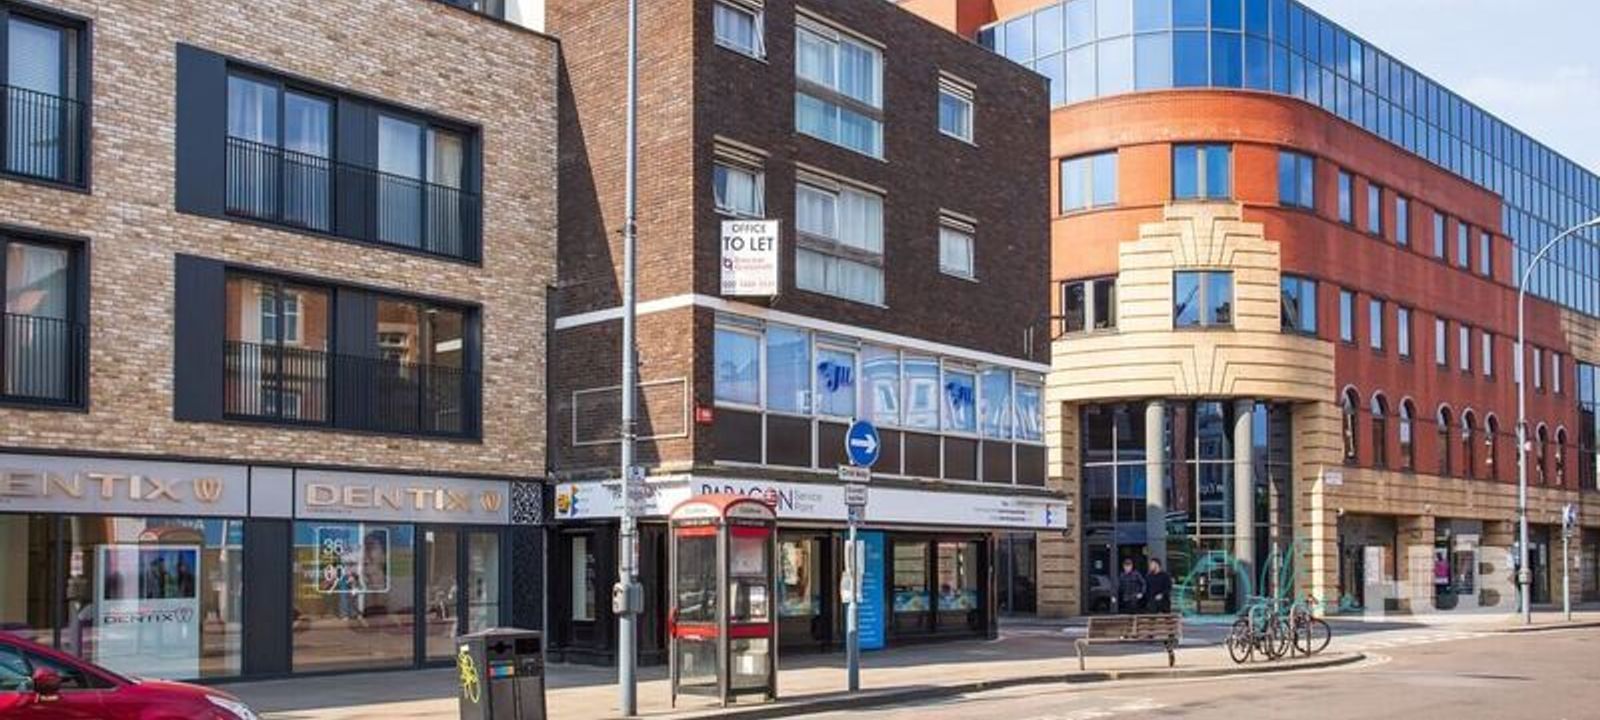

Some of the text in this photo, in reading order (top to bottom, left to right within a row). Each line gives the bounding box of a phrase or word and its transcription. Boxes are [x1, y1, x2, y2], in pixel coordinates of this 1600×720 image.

[732, 224, 766, 233] OFFICE
[724, 236, 773, 251] TO LET
[306, 483, 473, 512] DENTIX
[104, 614, 173, 624] DENTIX
